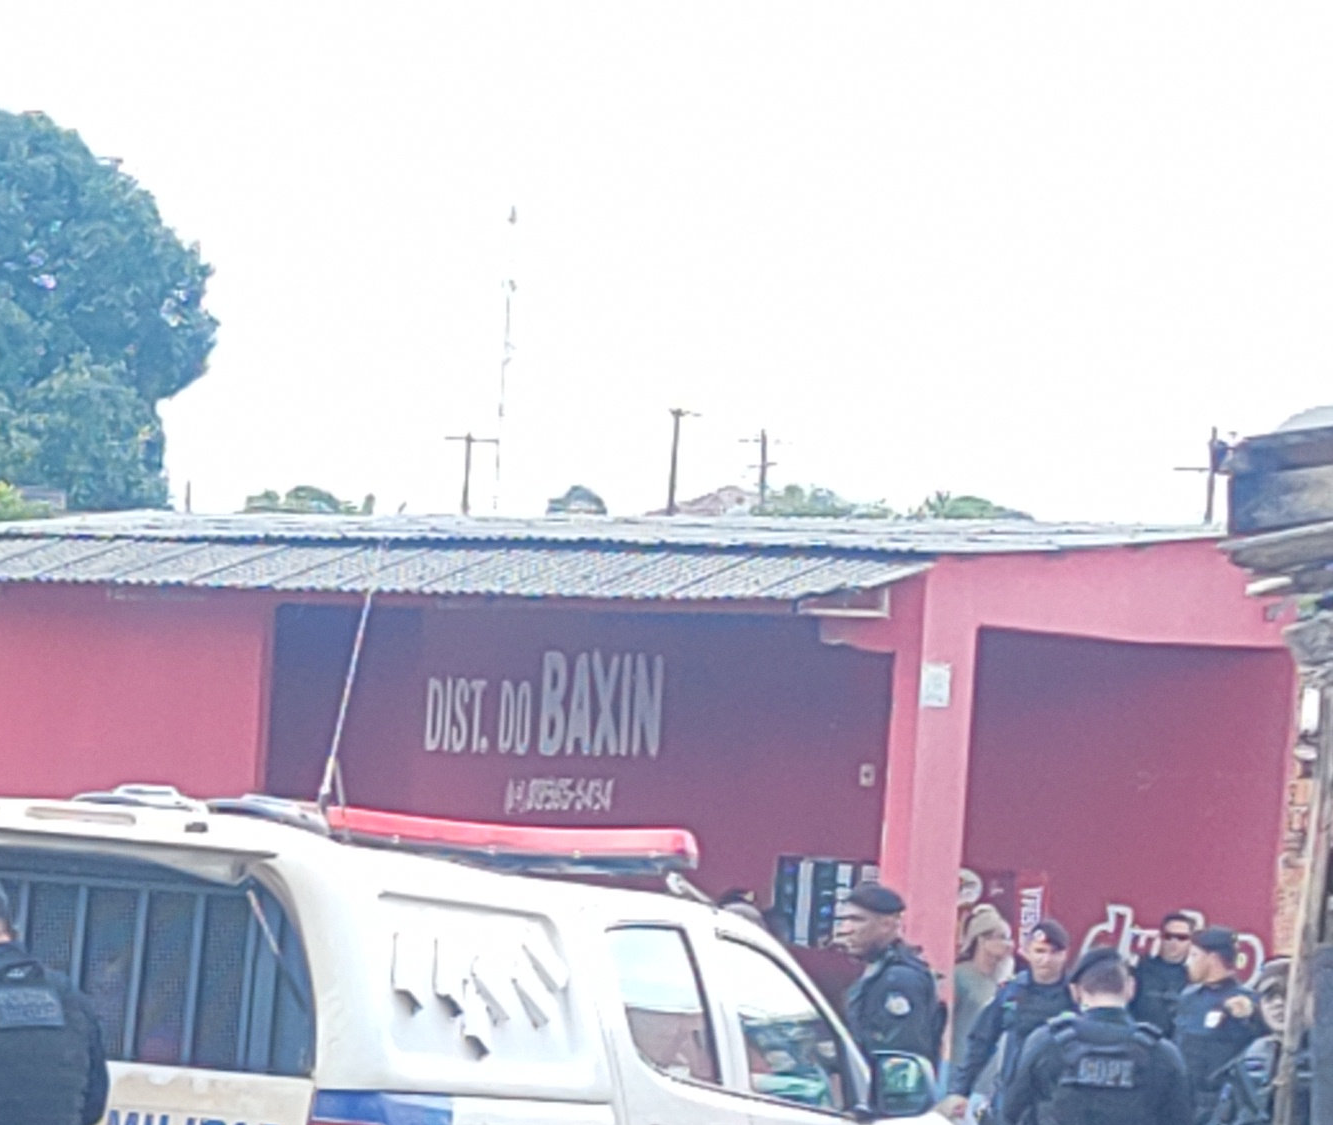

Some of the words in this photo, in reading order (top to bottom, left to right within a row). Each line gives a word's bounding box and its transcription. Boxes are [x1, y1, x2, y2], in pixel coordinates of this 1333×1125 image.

[423, 675, 487, 754] DIST.
[497, 679, 531, 755] DO
[538, 649, 665, 758] BAXIN
